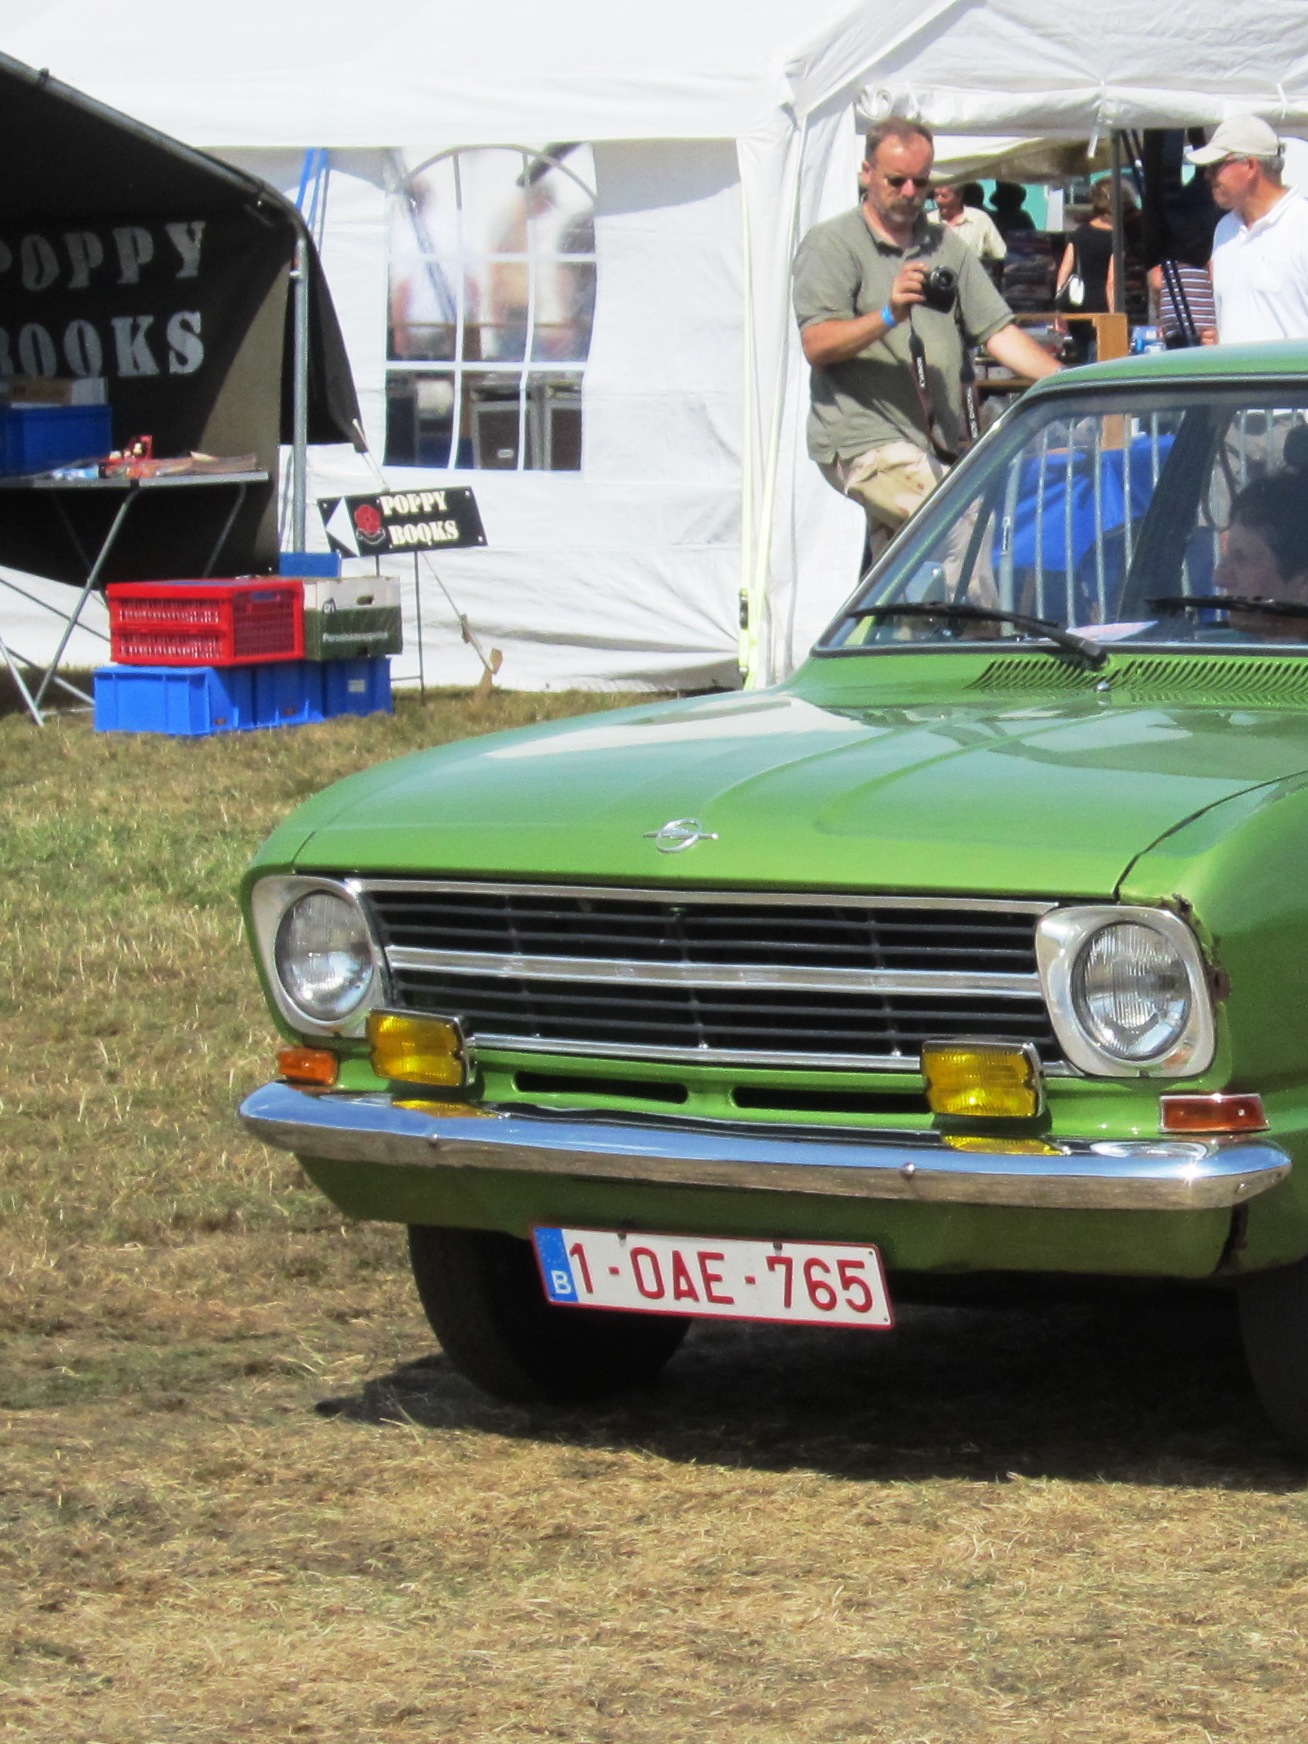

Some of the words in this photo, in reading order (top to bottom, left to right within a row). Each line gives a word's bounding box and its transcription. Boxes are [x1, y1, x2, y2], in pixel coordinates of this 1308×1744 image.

[379, 490, 448, 516] POPPY
[387, 519, 459, 546] BOOKS
[551, 1269, 572, 1295] B
